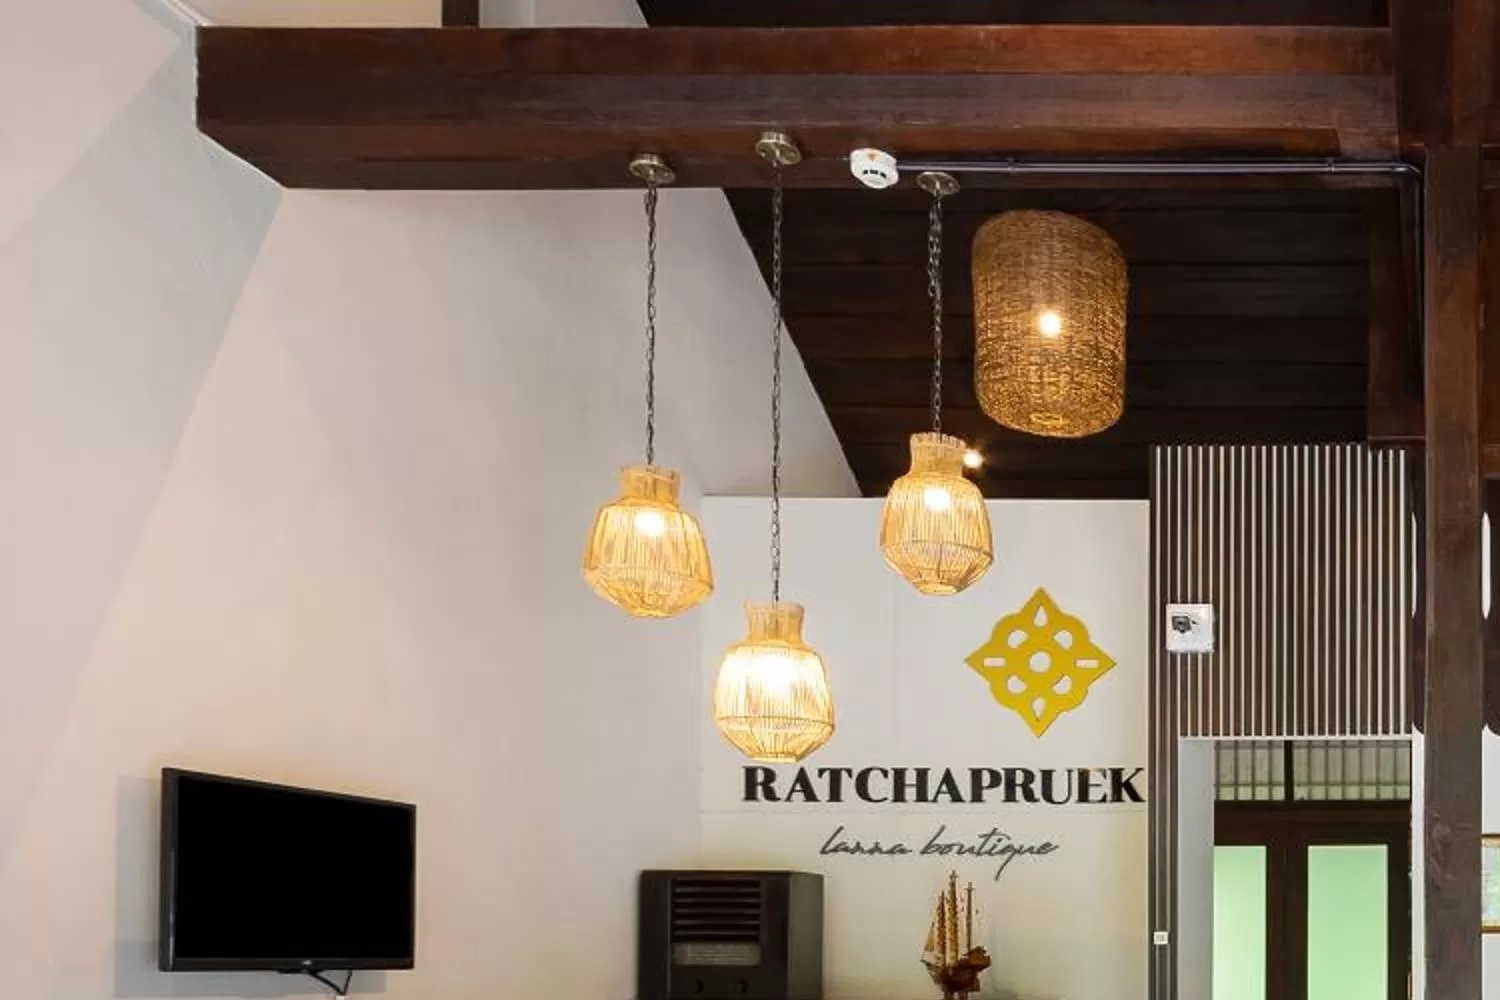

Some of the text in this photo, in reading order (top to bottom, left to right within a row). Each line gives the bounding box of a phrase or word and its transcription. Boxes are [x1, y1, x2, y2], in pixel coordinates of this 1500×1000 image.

[742, 765, 1147, 805] RATCHAPRUEK
[820, 825, 1060, 882] lanna boutique
